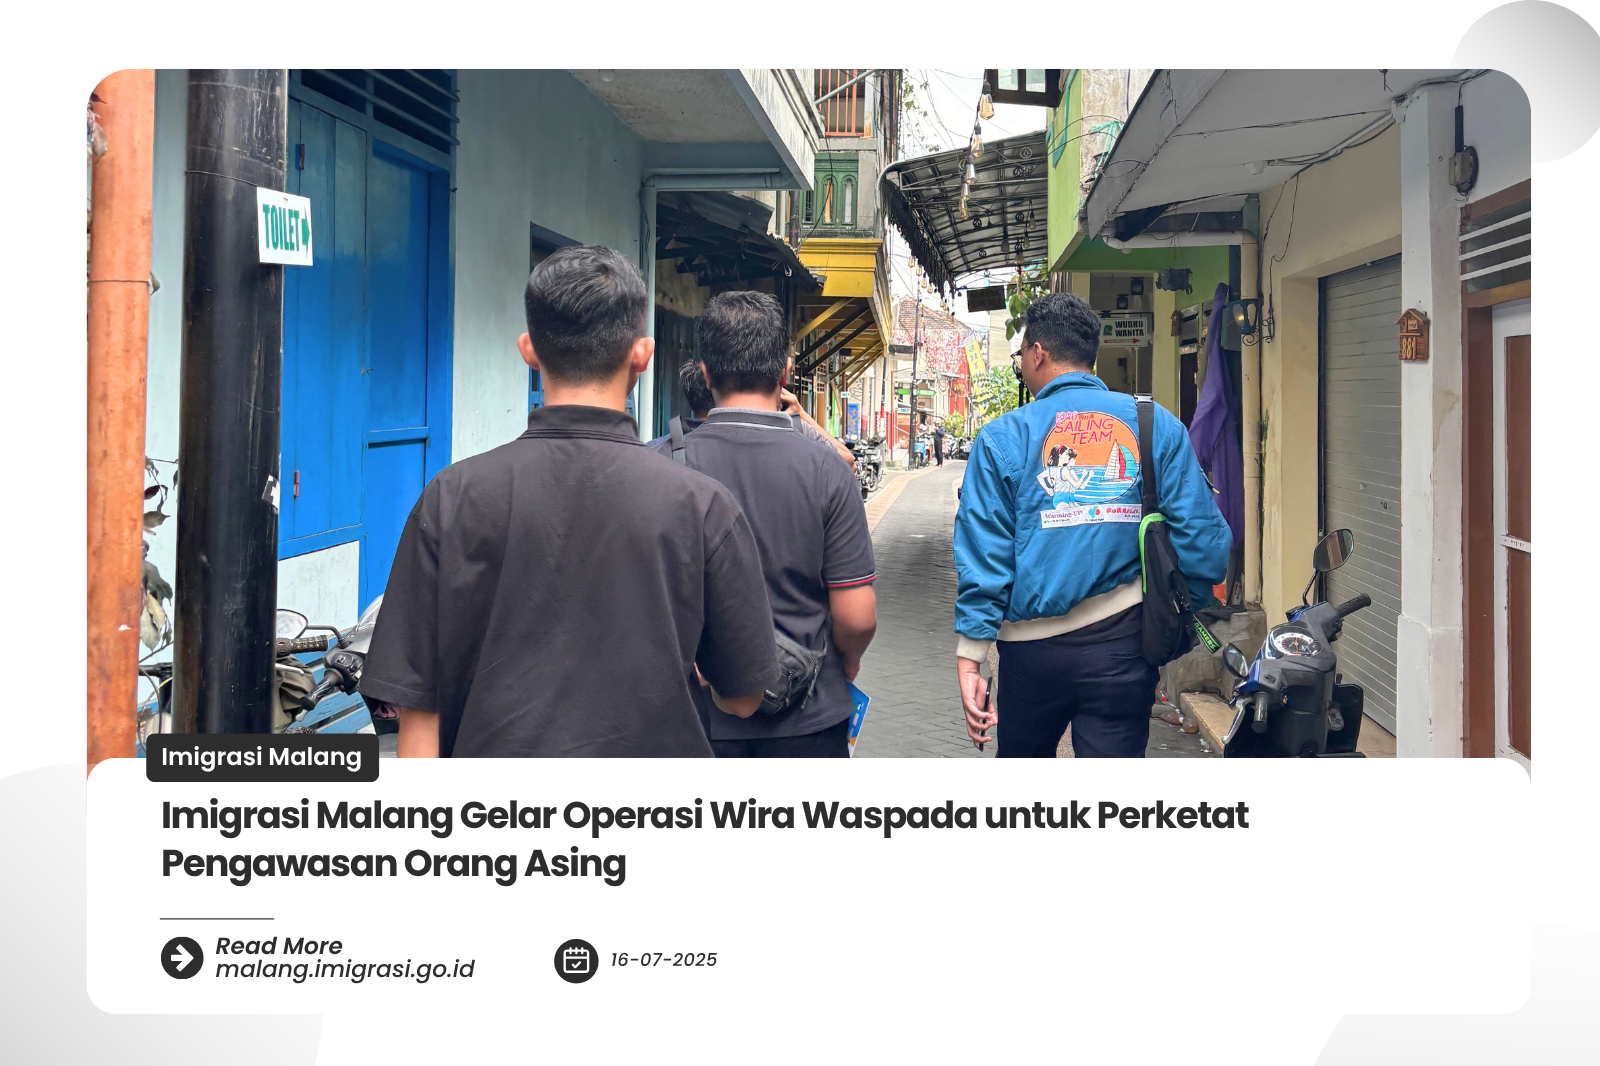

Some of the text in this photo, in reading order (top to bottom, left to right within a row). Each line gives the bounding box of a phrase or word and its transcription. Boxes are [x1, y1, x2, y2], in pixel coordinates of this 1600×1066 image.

[262, 204, 299, 251] TOILET
[1115, 320, 1143, 329] WUDHU
[1115, 329, 1144, 337] WANITA
[1402, 337, 1416, 359] 881
[1054, 418, 1115, 434] SAILING
[1070, 430, 1113, 444] TEAM
